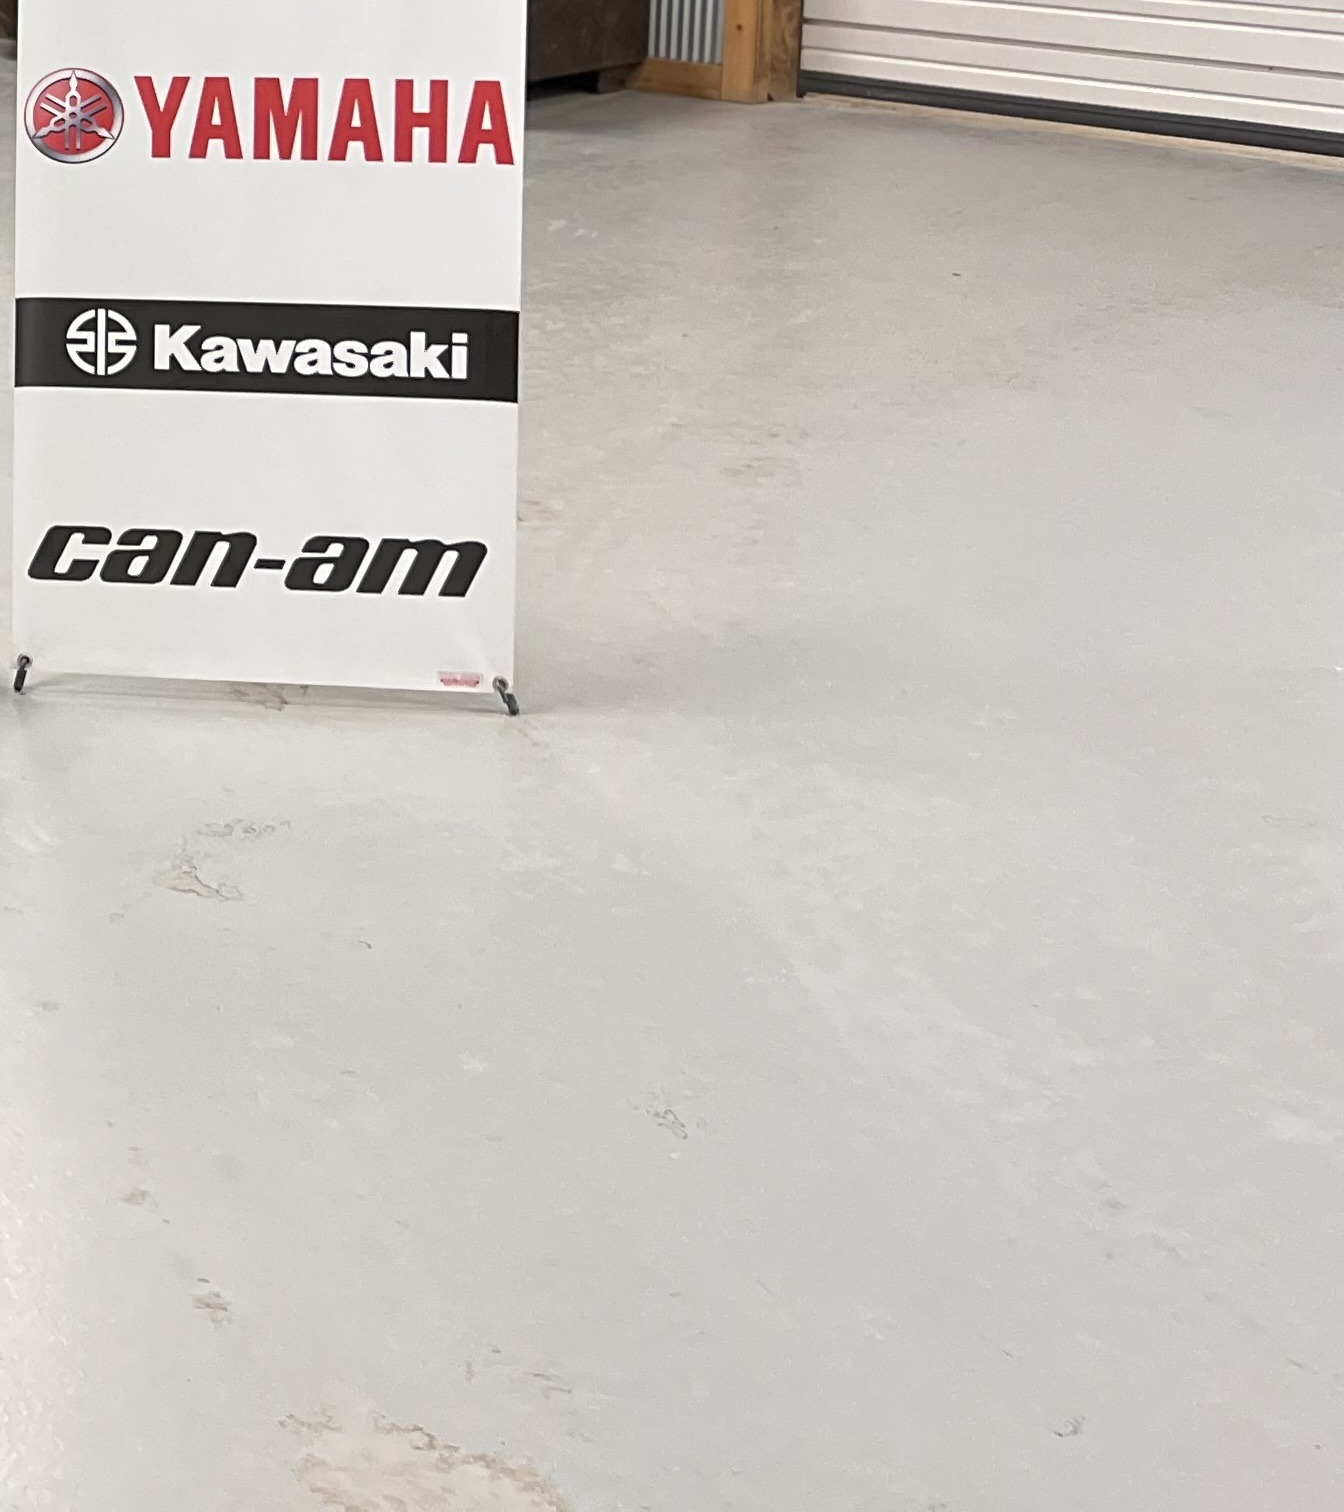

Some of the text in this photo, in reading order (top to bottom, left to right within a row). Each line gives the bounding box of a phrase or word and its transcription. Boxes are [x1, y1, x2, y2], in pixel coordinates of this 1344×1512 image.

[133, 74, 515, 166] YAMAHA
[153, 322, 470, 381] Kawasaki
[27, 524, 489, 599] can-am
